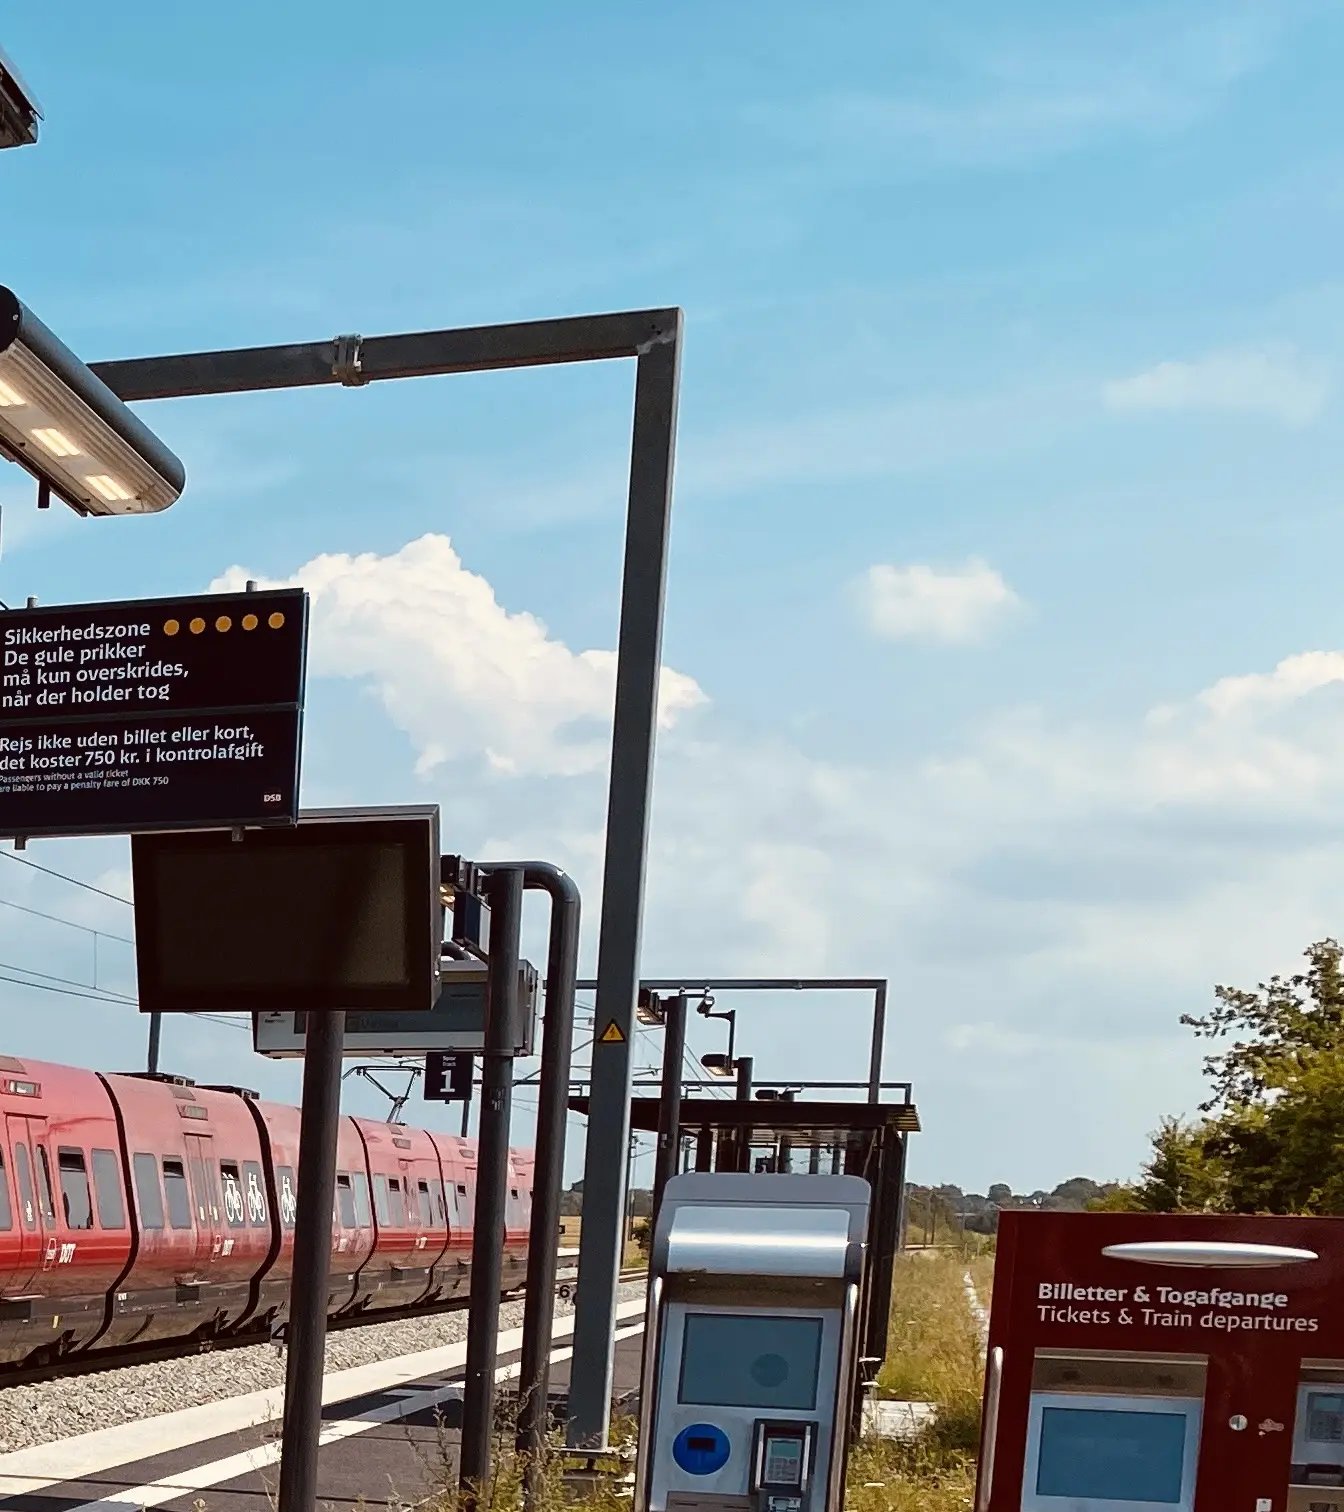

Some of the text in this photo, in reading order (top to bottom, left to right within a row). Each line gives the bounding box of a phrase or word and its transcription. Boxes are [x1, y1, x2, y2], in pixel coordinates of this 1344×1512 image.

[4, 623, 151, 646] Sikkerhedszone
[4, 643, 146, 667] De gule prikker
[3, 661, 189, 687] må kun overskrides,
[2, 684, 170, 708] når der holder tog
[0, 725, 255, 754] Rejs ikke uden billet eller kort,
[30, 753, 82, 769] koster
[85, 751, 115, 766] 750
[120, 750, 140, 764] kr.
[145, 749, 151, 763] i
[156, 742, 264, 762] kontrolafgift
[36, 783, 45, 791] to
[47, 783, 62, 793] pay
[103, 779, 120, 788] fare
[121, 778, 131, 786] of
[152, 776, 169, 785] 750
[43, 772, 75, 781] without
[84, 770, 104, 779] valid
[440, 1070, 456, 1093] 1
[59, 1243, 76, 1264] DOT
[1037, 1283, 1289, 1311] Billetter & Togafgange
[1037, 1305, 1319, 1333] Tickets & Train departures
